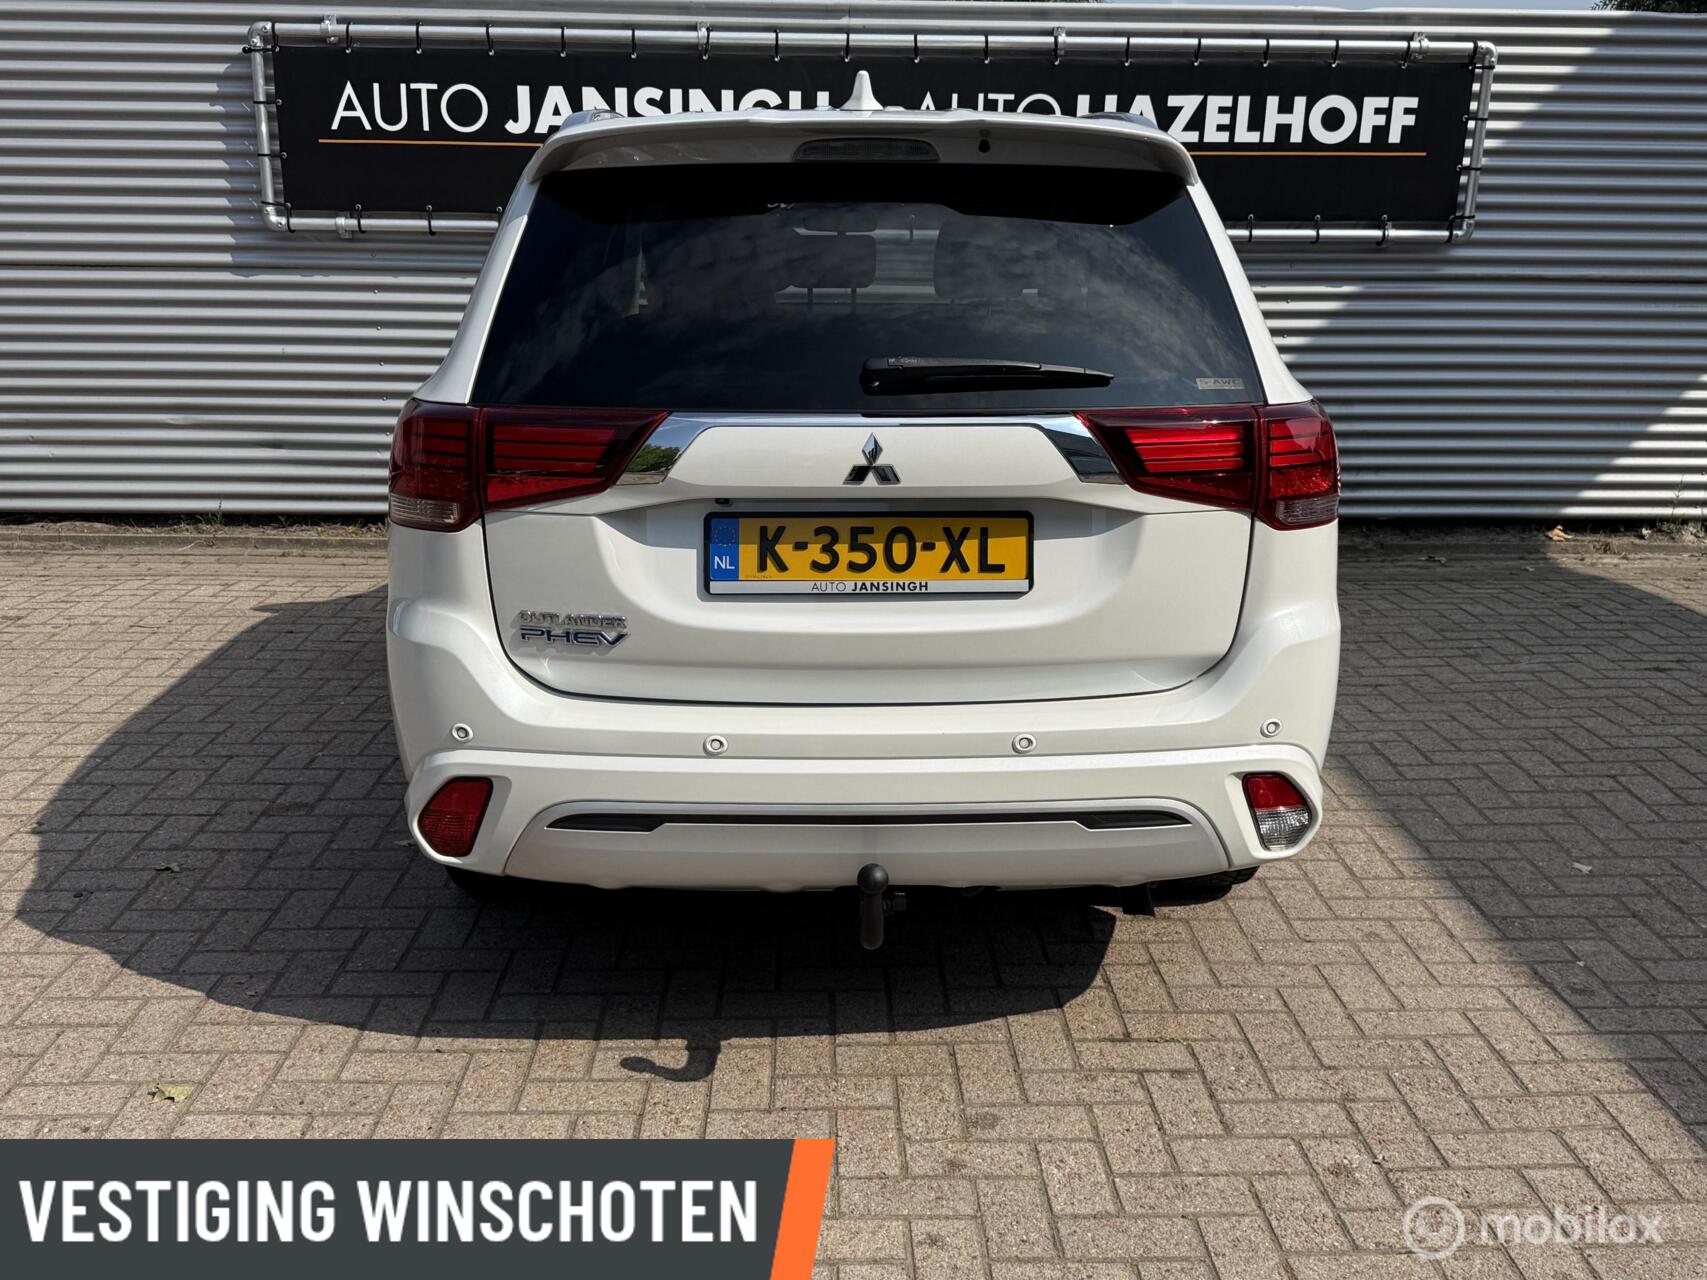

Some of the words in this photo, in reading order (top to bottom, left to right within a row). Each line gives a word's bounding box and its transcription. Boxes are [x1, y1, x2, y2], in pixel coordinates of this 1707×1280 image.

[331, 81, 488, 133] AUTO
[757, 525, 1005, 574] K-350-XL
[714, 555, 735, 569] NL
[811, 583, 846, 592] AUTO
[851, 581, 928, 592] JANSINGH
[519, 625, 629, 646] PHEV
